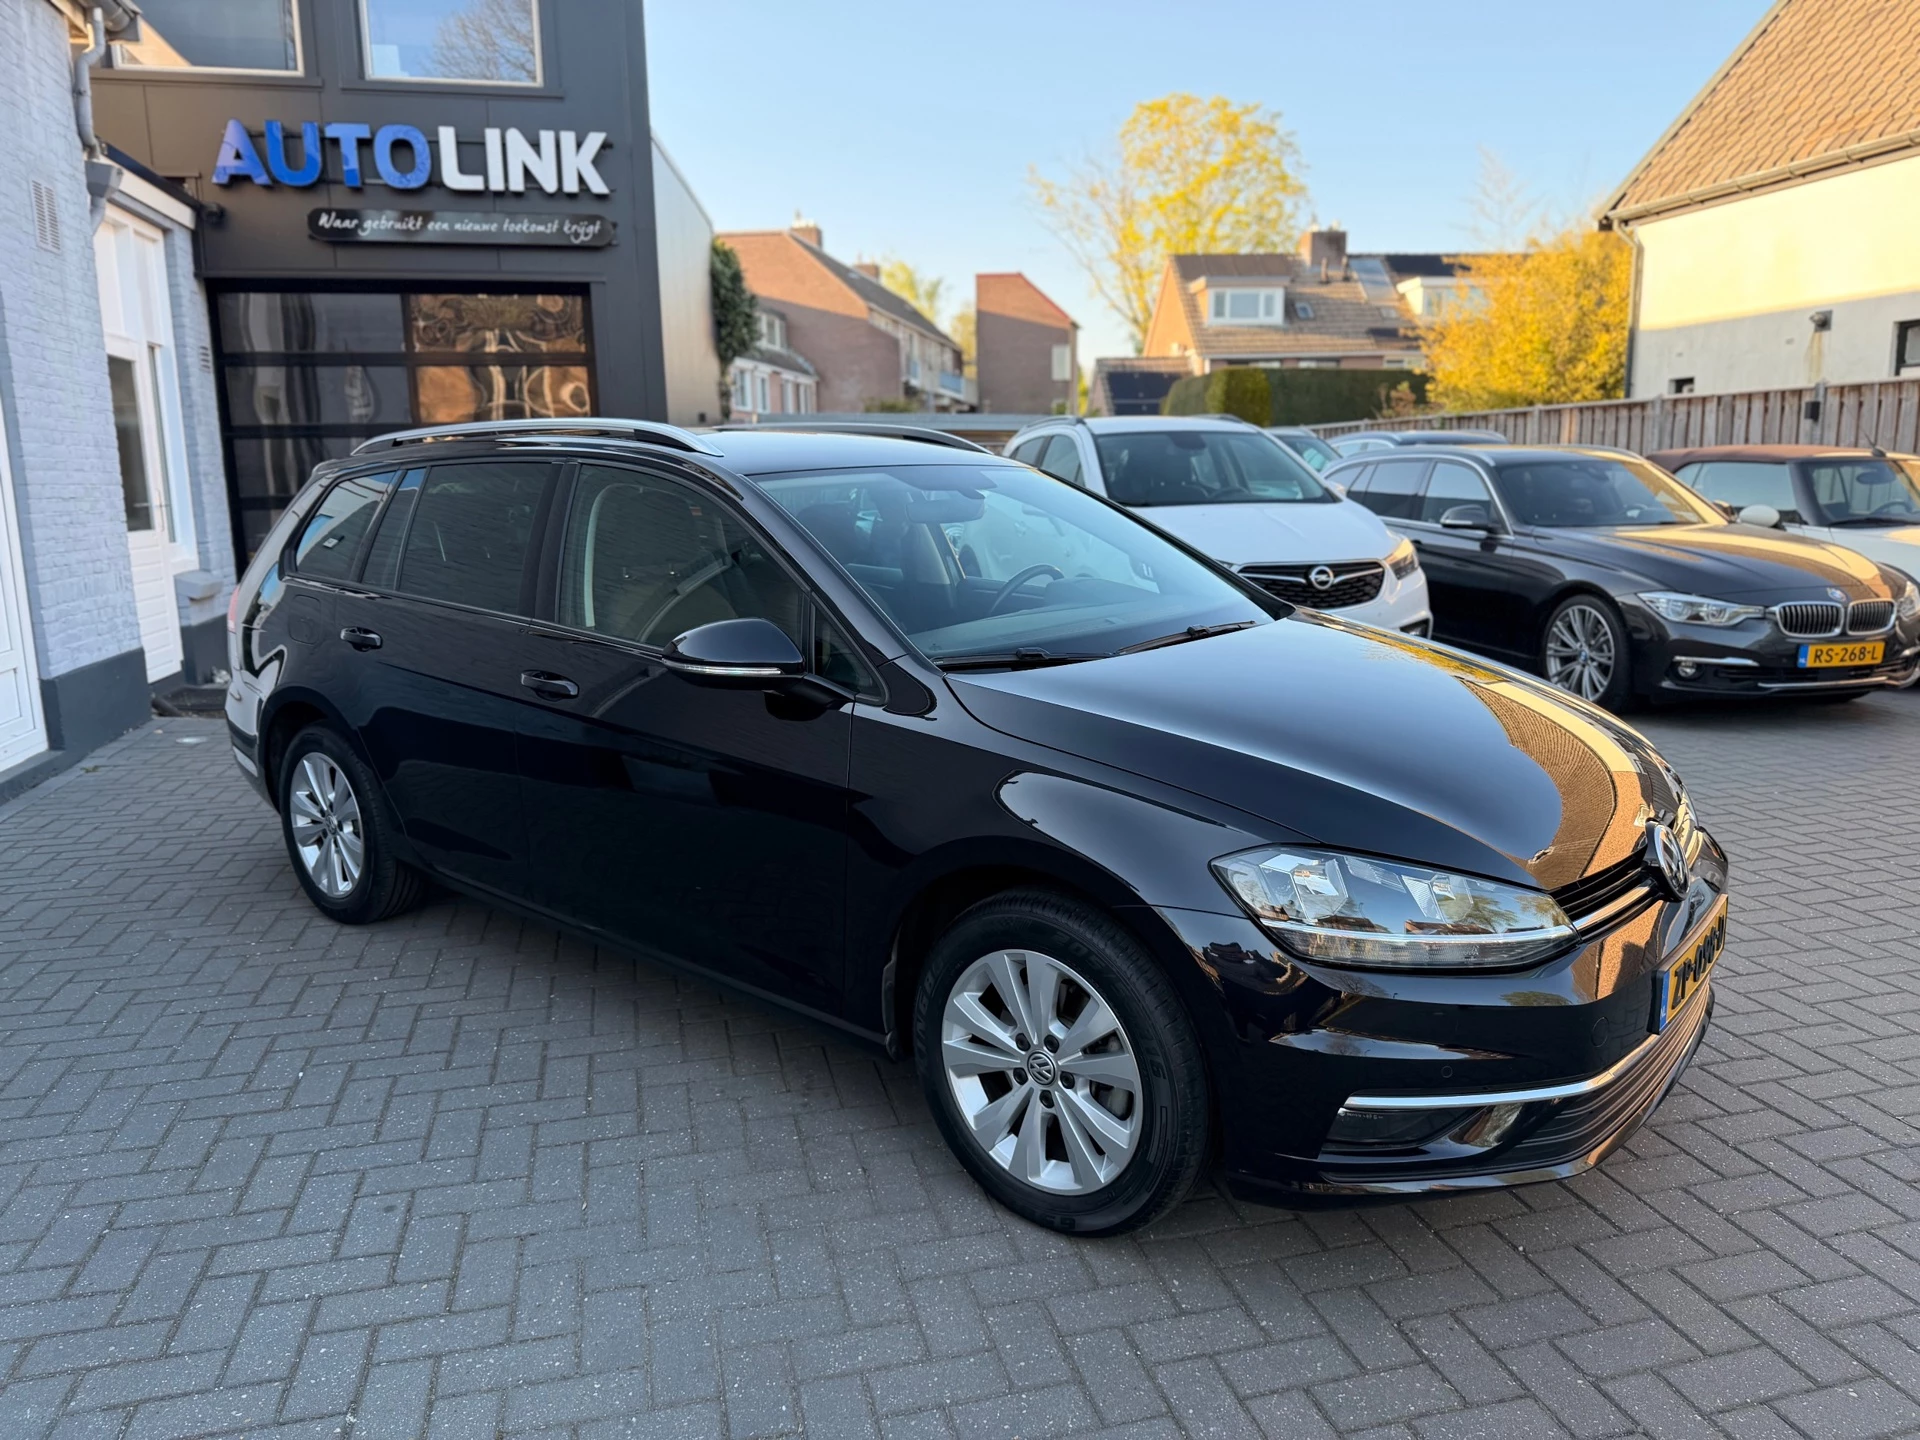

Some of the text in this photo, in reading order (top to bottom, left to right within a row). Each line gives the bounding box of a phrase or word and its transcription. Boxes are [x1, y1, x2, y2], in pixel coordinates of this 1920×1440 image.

[211, 118, 610, 195] AUTOLINK
[318, 211, 602, 244] Waar gebruikt een nieuwe toekomst krijgt
[1813, 645, 1878, 663] RS-268-L
